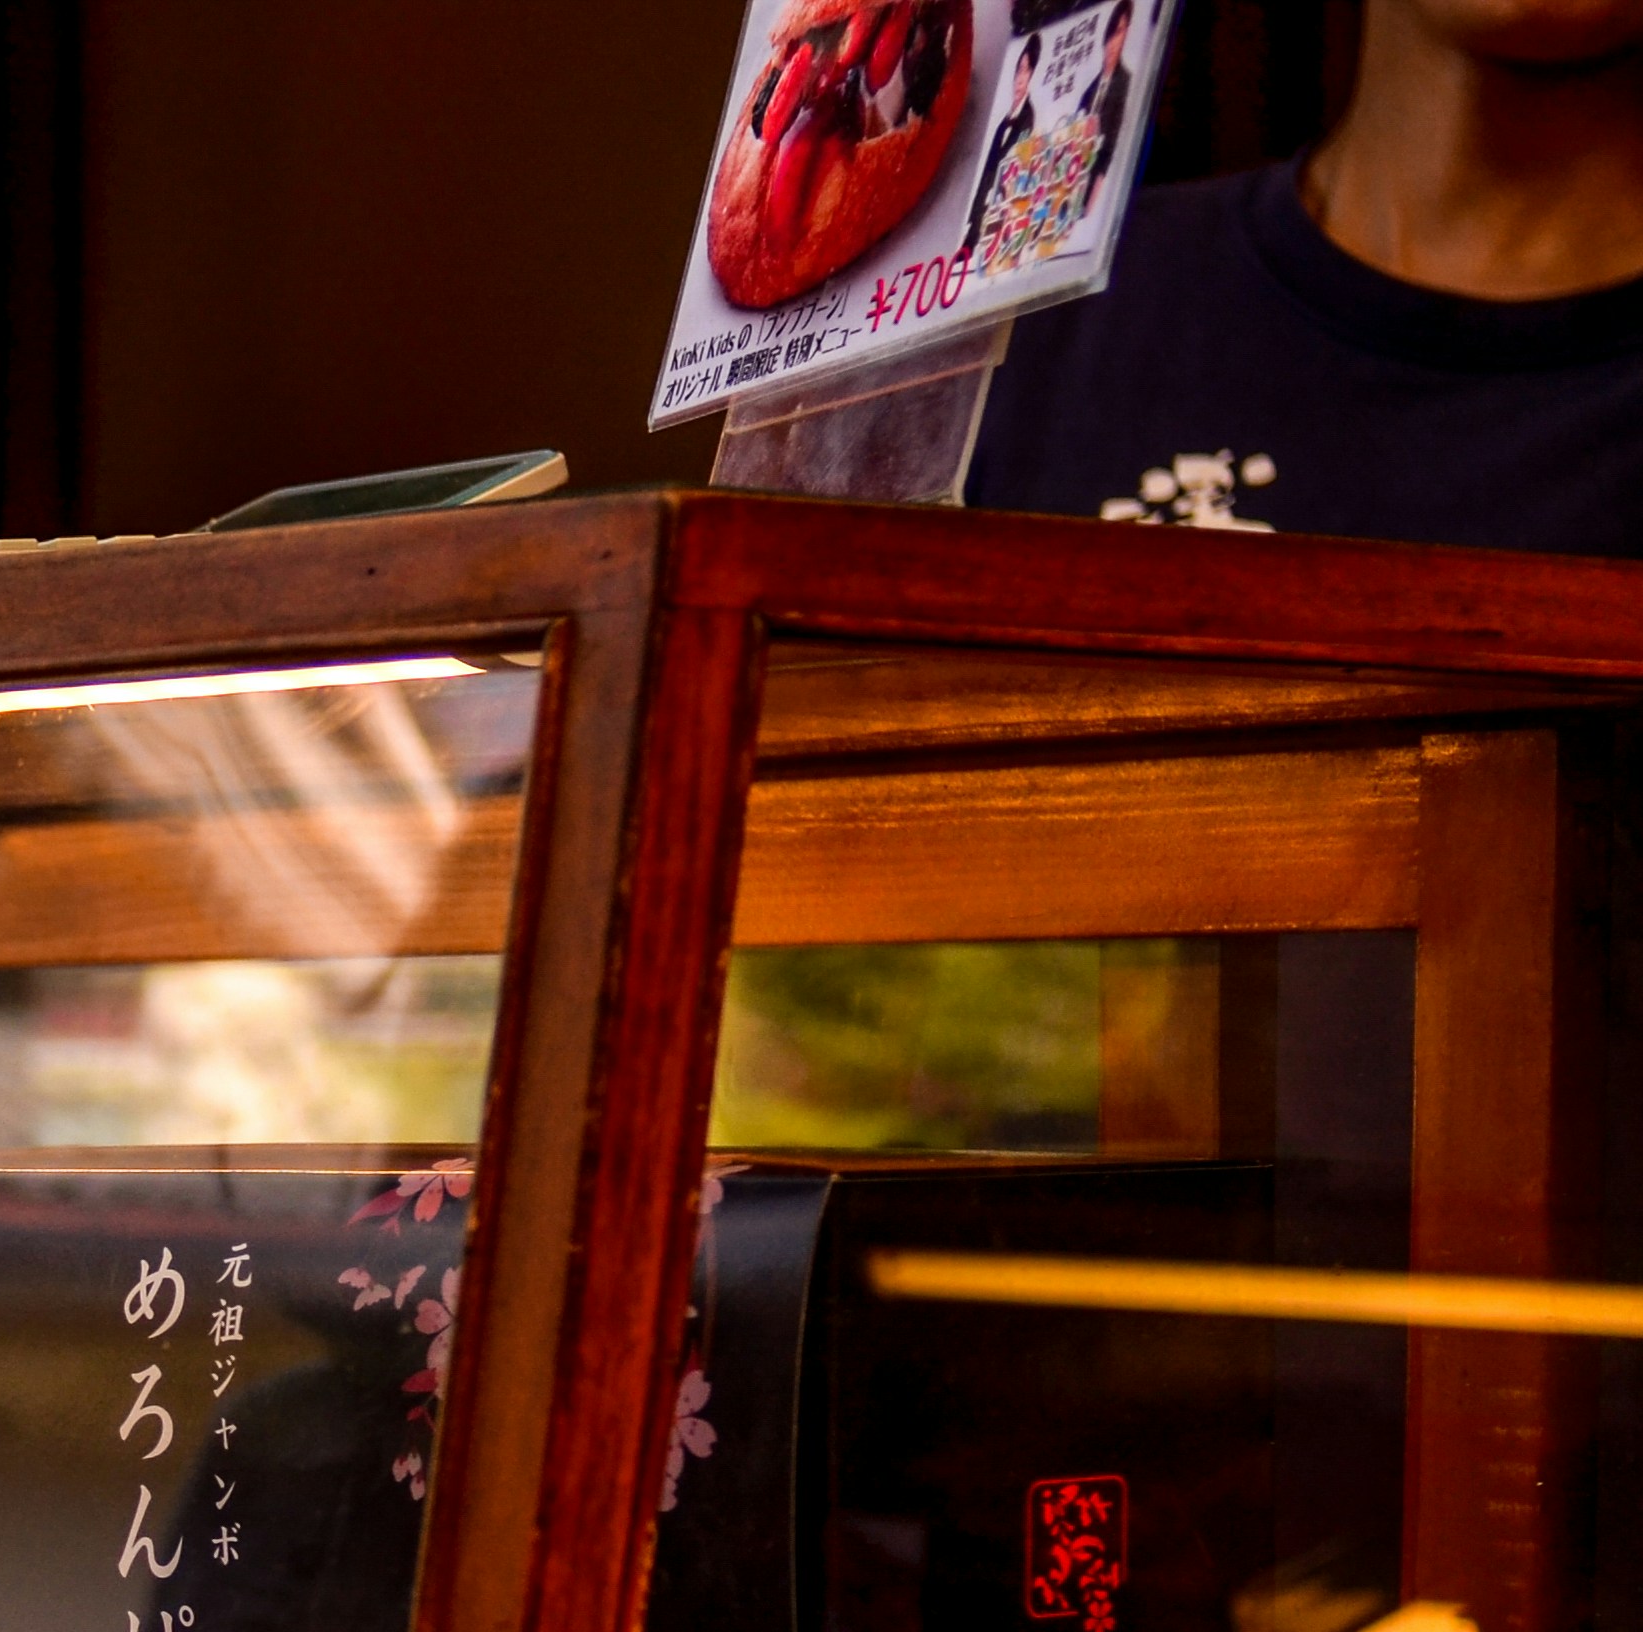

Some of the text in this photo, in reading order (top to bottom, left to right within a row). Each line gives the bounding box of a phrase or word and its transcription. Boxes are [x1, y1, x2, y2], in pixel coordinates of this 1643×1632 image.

[866, 247, 973, 332] ¥700
[661, 370, 721, 408] オリジナル
[783, 327, 863, 371] 特別メニュー
[670, 336, 706, 372] KinKi
[708, 332, 734, 363] Kids
[209, 1242, 253, 1566] 元祖ジャンボ
